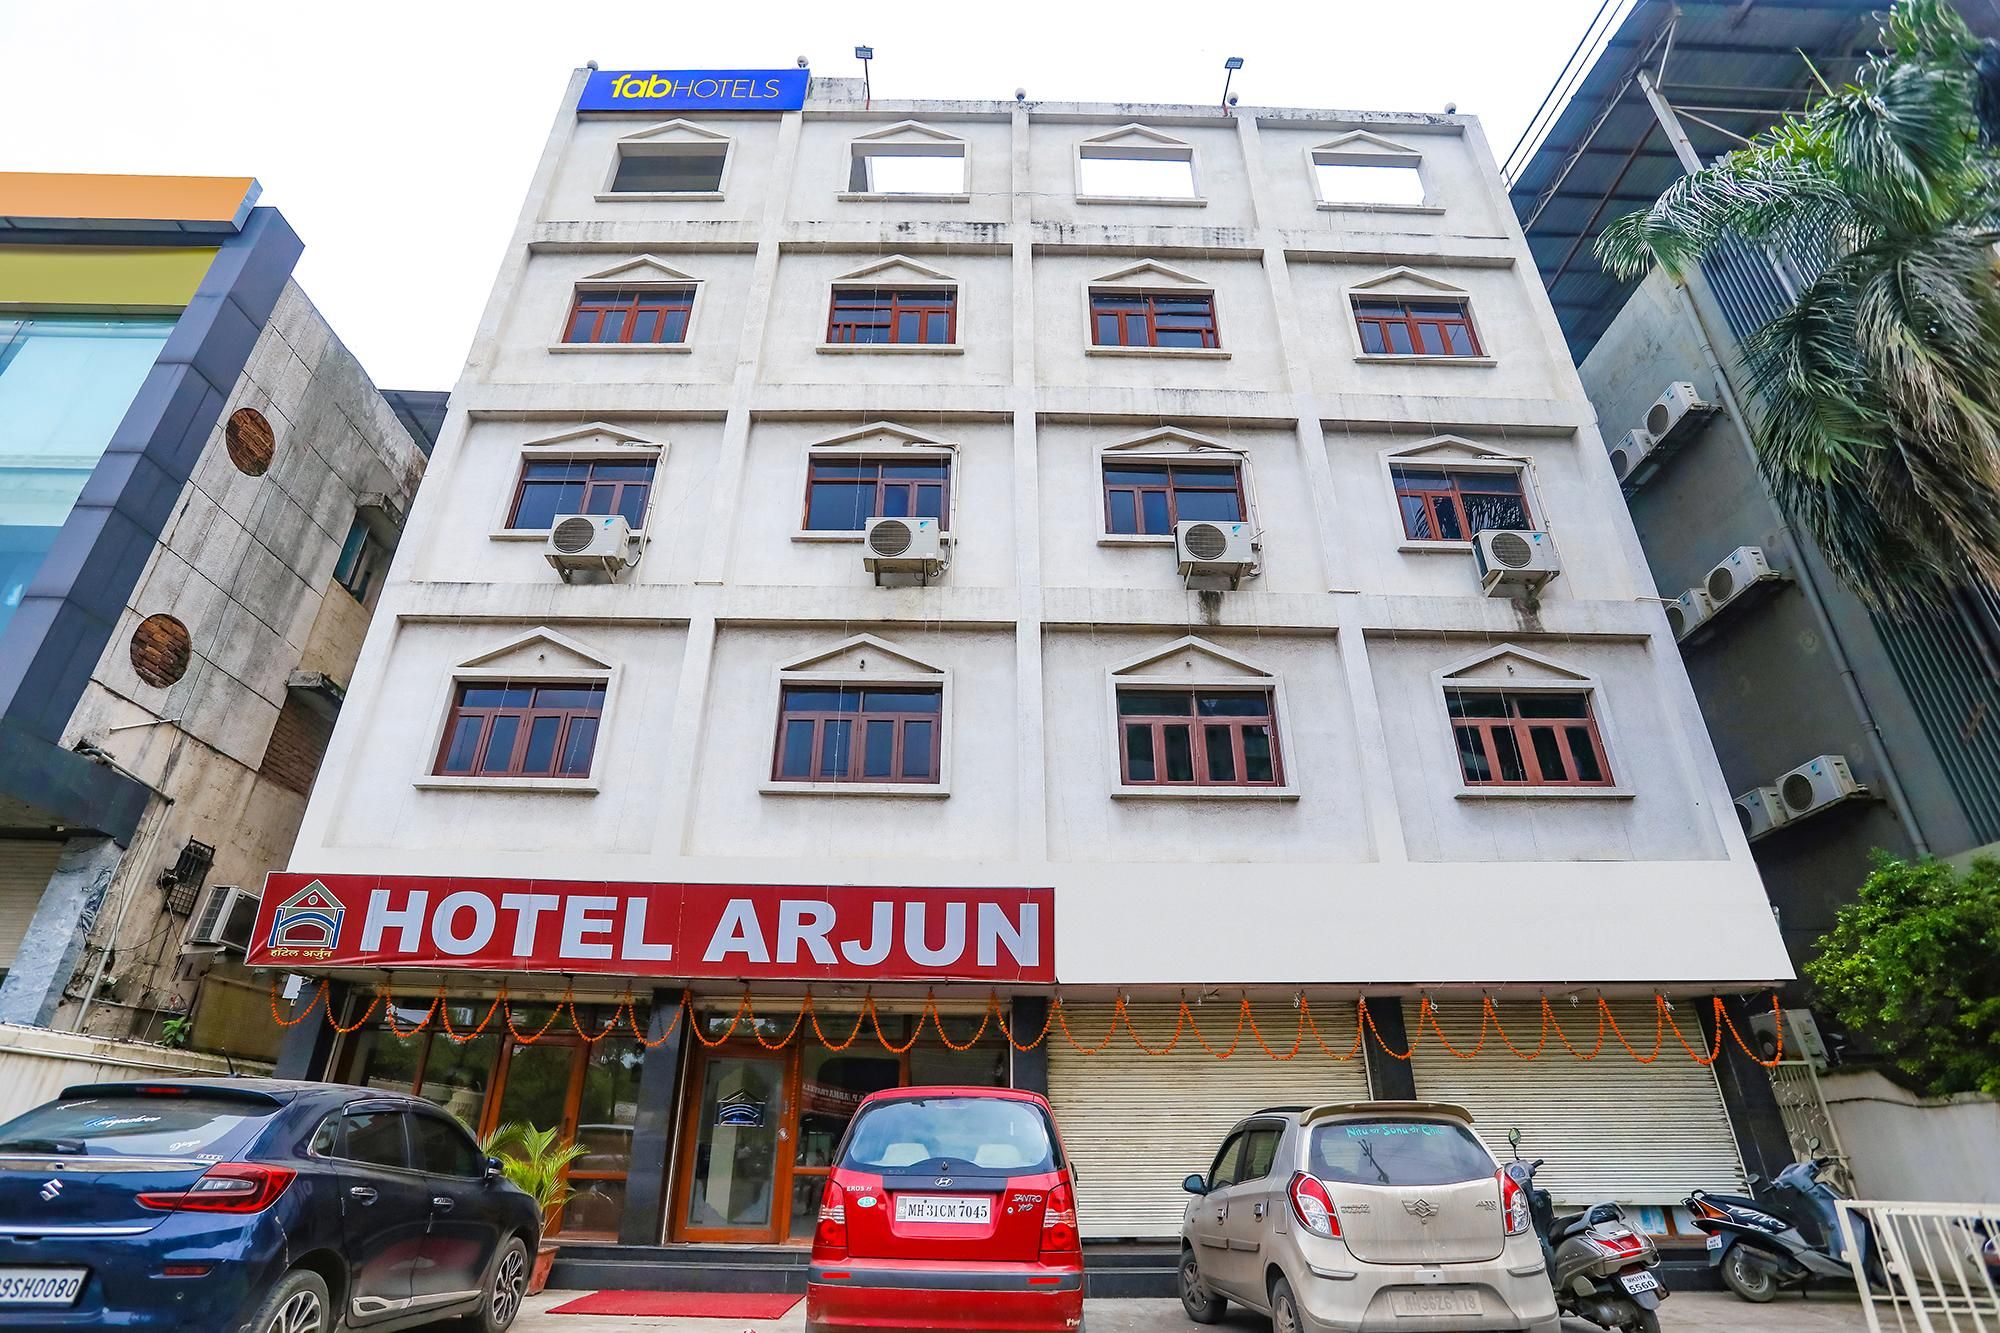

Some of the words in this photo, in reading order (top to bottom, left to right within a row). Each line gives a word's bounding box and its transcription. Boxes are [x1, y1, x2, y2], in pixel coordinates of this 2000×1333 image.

[360, 890, 673, 961] HOTEL
[701, 897, 1039, 968] ARJUN
[303, 948, 332, 960] अर्जुन
[908, 1203, 924, 1218] MH
[926, 1204, 956, 1218] 31CM
[959, 1205, 988, 1219] 7045
[0, 1278, 79, 1298] 9SH0080
[1629, 1280, 1655, 1293] 5560
